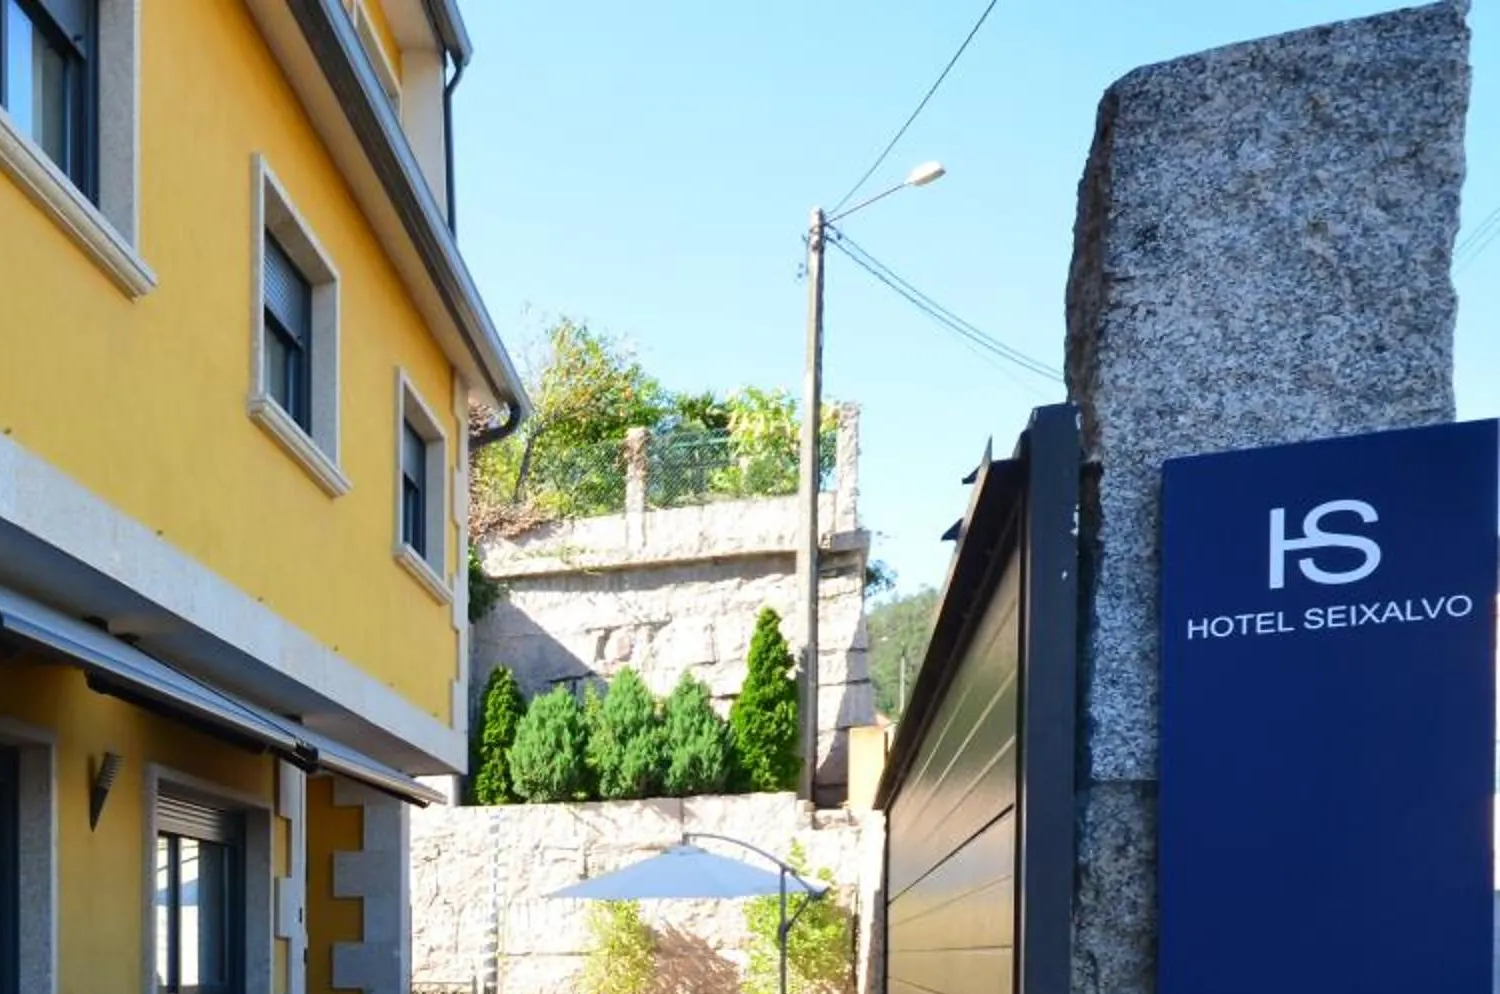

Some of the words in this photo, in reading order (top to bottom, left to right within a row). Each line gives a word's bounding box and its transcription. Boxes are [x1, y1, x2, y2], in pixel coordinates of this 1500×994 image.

[1268, 499, 1382, 590] HS
[1187, 611, 1295, 640] HOTEL
[1303, 594, 1474, 631] SEIXALVO
